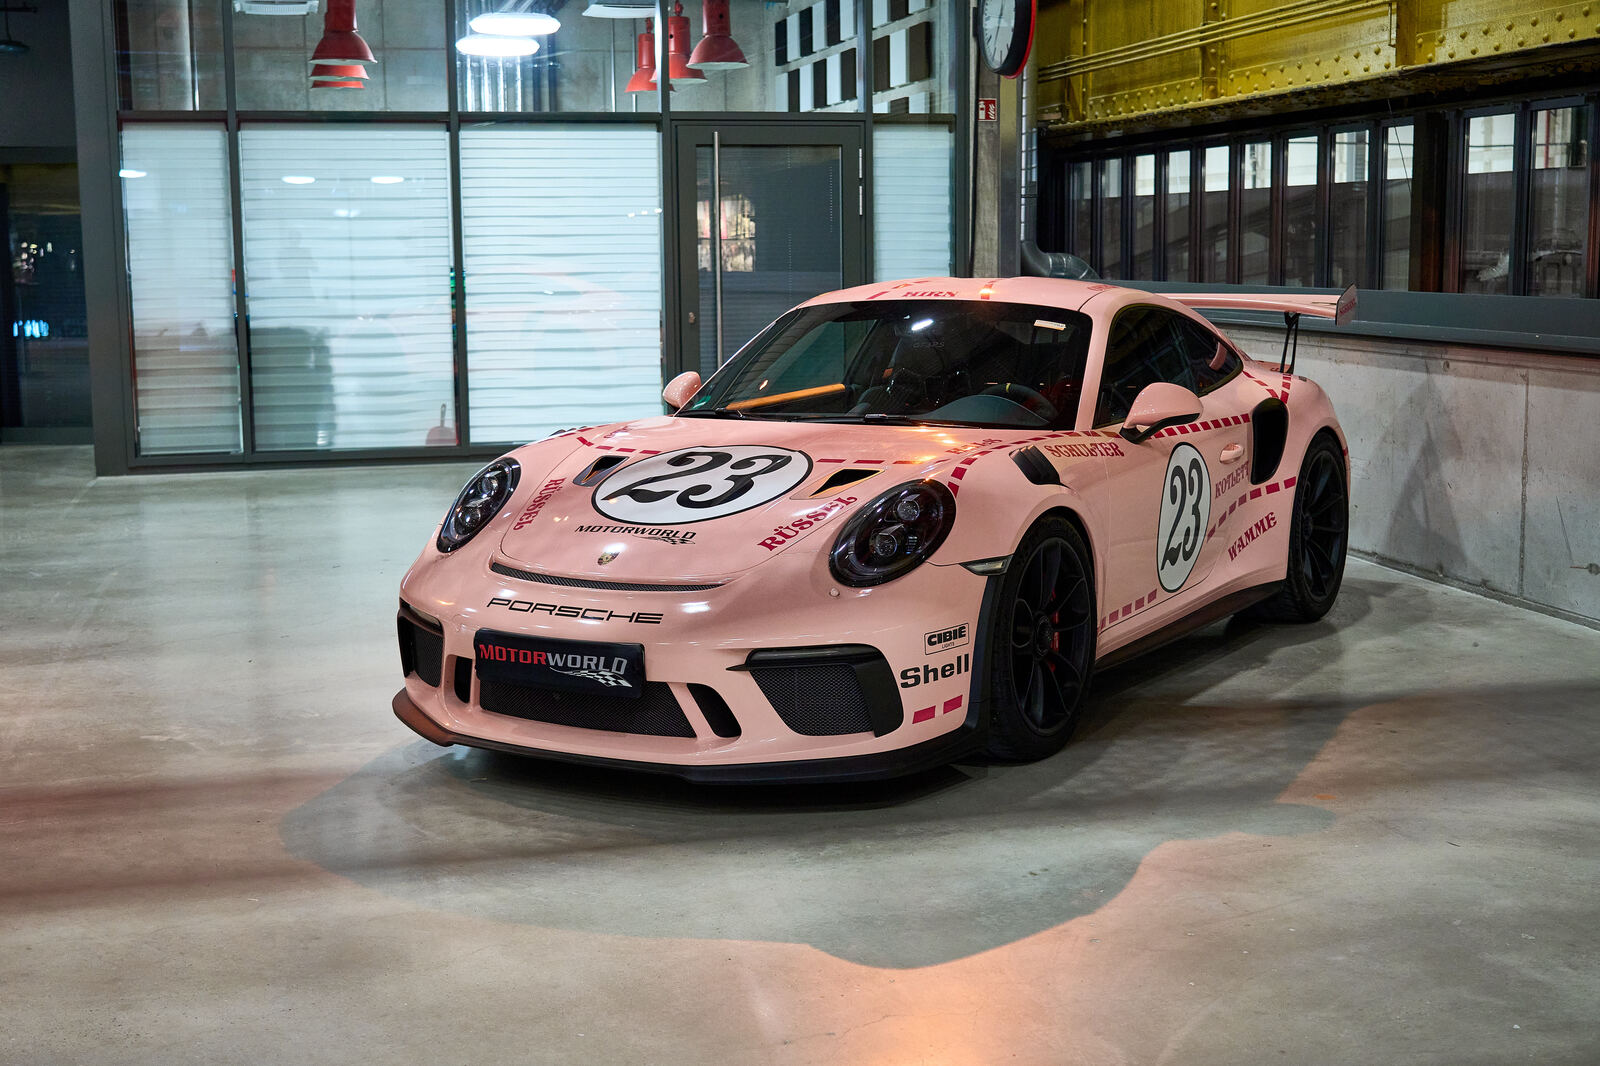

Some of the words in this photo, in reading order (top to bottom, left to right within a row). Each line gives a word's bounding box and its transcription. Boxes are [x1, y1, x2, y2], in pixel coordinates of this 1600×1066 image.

[1044, 442, 1125, 458] SCHULTER
[601, 451, 792, 508] 23
[513, 478, 567, 530] RÜSSEL
[1161, 458, 1203, 570] 23
[575, 525, 697, 540] MOTORWORLD
[757, 496, 857, 551] RÜSSEL
[1228, 512, 1277, 561] WAMME
[487, 597, 664, 624] PORSCHE
[927, 626, 966, 646] CIBIE
[479, 644, 628, 675] MOTORWORLD
[900, 653, 969, 688] Shell
